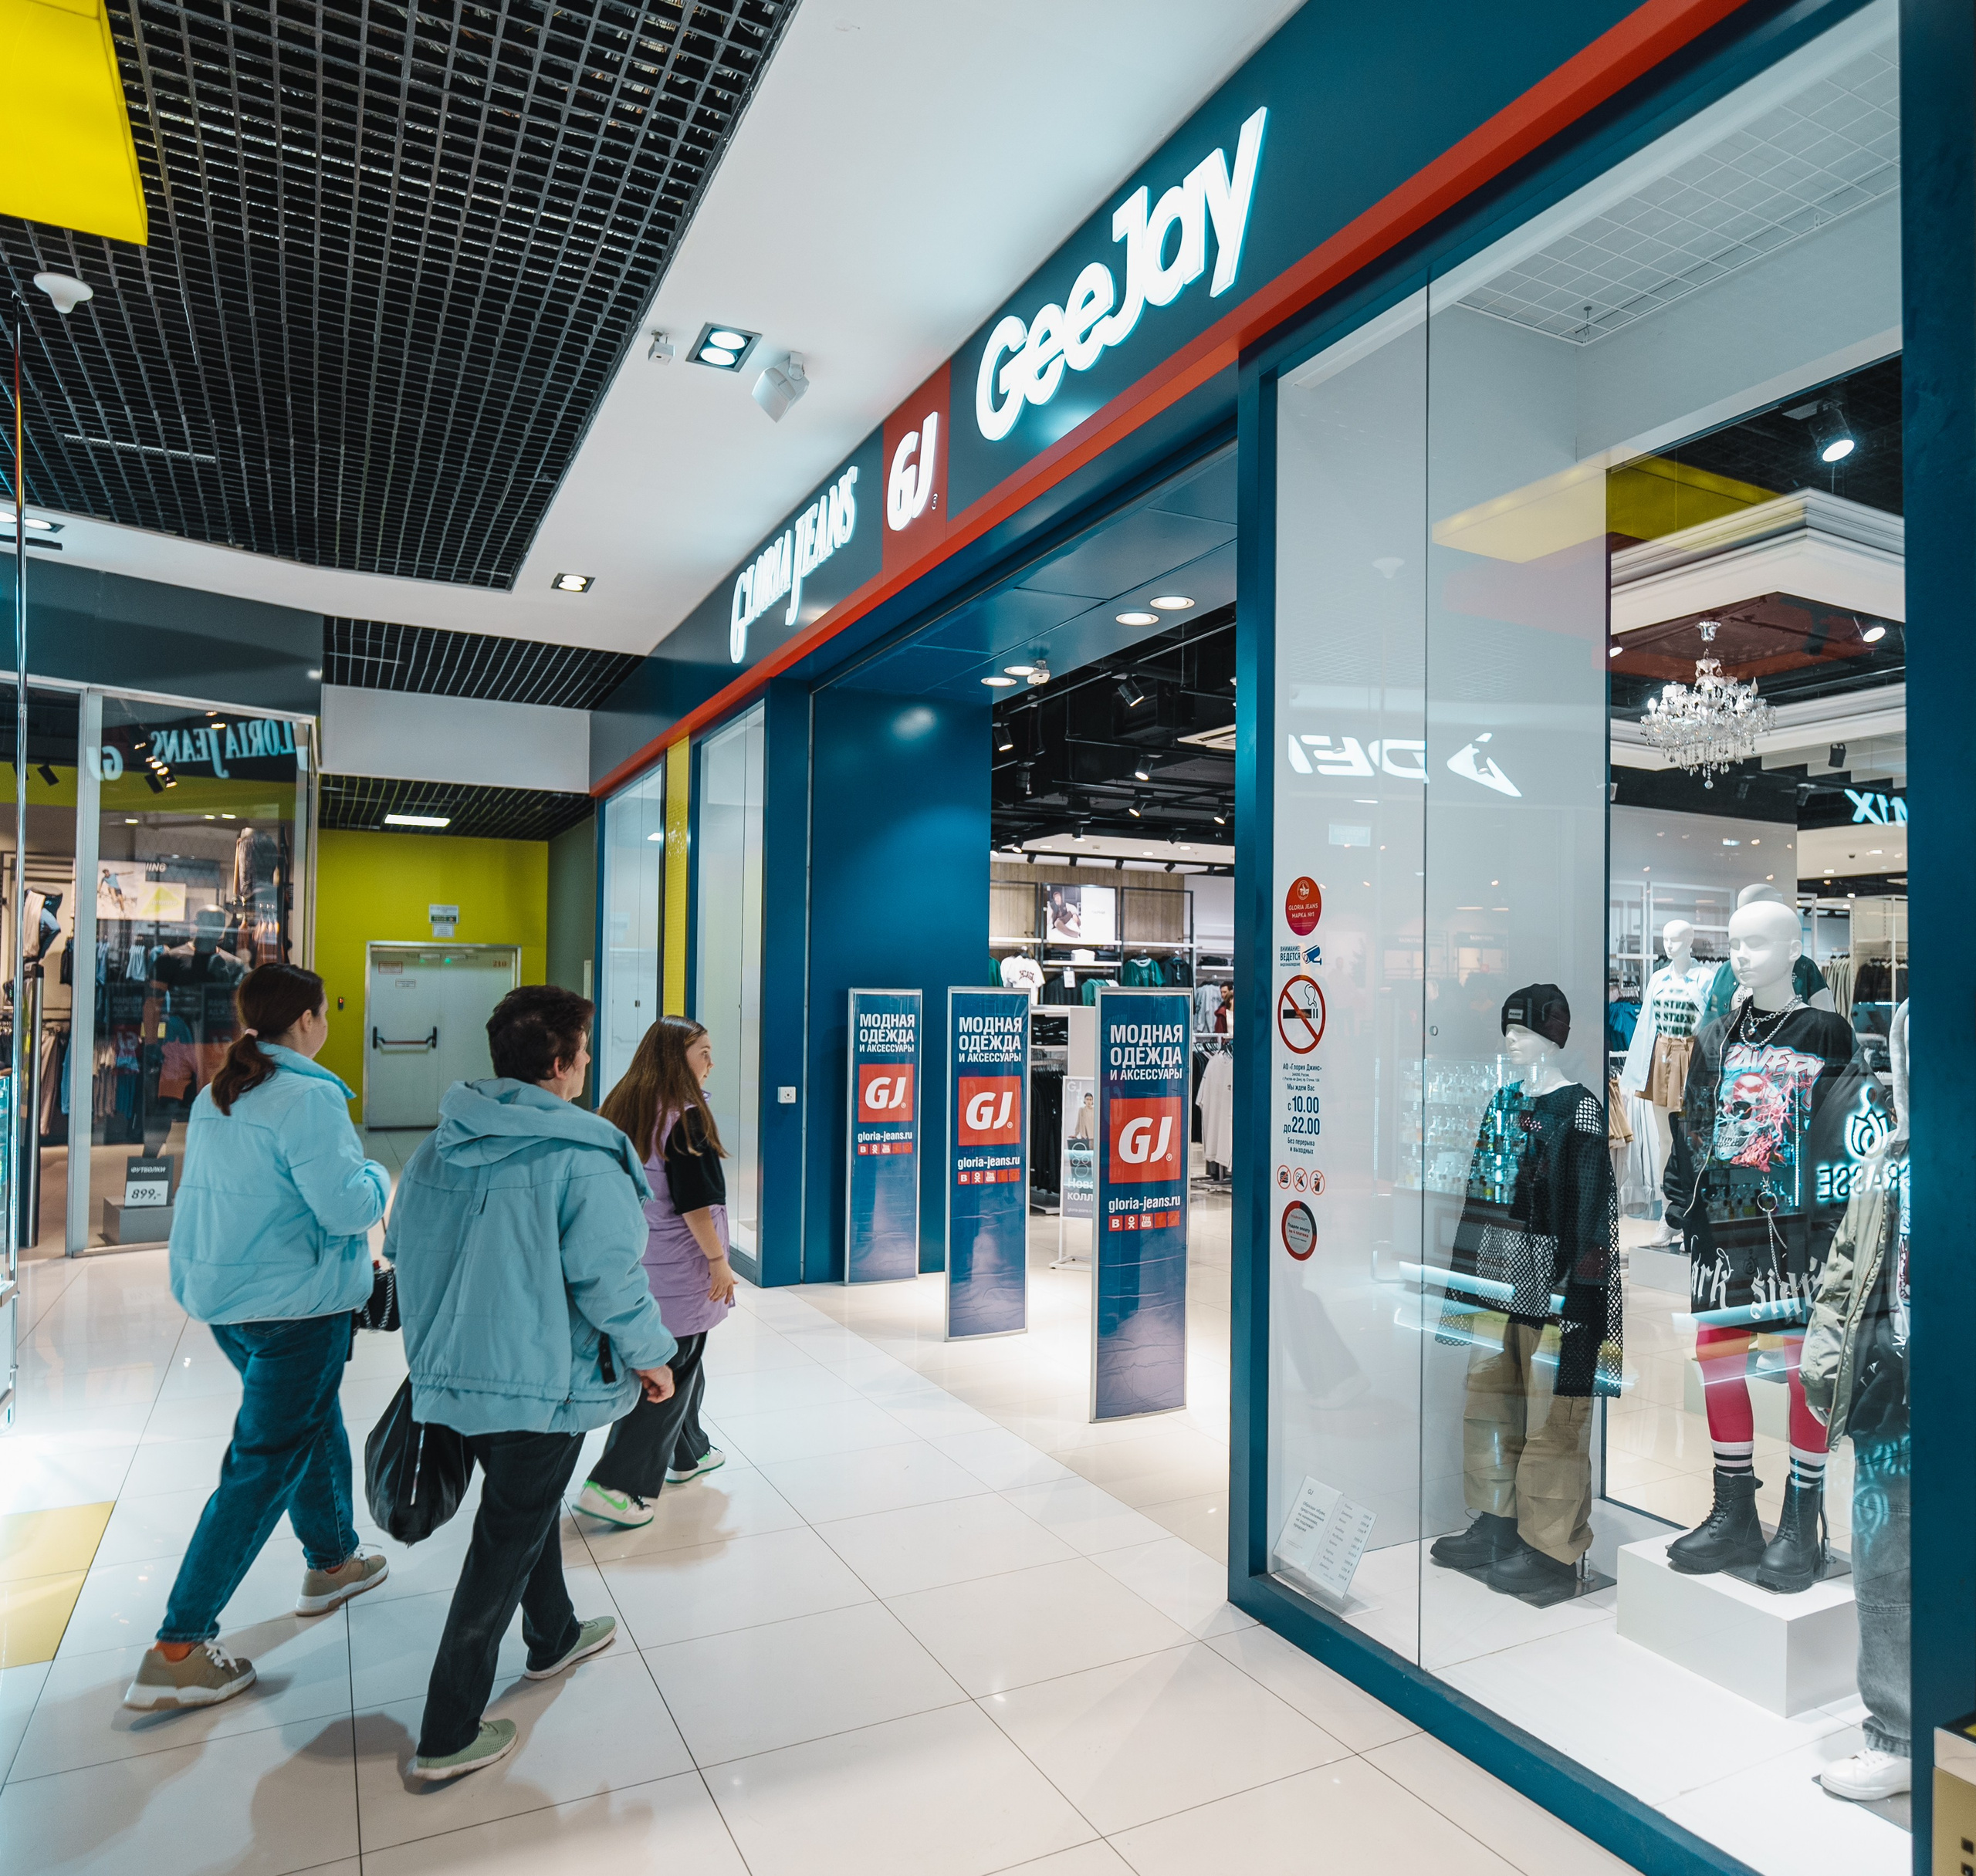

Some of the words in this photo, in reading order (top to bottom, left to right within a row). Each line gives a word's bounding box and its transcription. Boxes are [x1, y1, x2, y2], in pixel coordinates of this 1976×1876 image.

[975, 106, 1268, 441] GeeJay
[887, 411, 939, 531] GJ
[729, 529, 792, 664] GLORIA
[784, 465, 859, 626] JEANS
[1280, 952, 1301, 962] ВЕДЕТСЯ
[859, 1013, 915, 1029] МОДНАЯ
[959, 1016, 1022, 1035] МОДНАЯ
[859, 1029, 915, 1044] ОДЕЖДА
[959, 1035, 1021, 1053] ОДЕЖДА
[1110, 1024, 1183, 1046] МОДНАЯ
[867, 1043, 915, 1053] АКСЕССУАРЫ
[1110, 1046, 1182, 1068] ОДЕЖДА
[959, 1053, 965, 1063] И
[967, 1053, 1021, 1063] АКСЕССУАРЫ
[1110, 1070, 1118, 1080] И
[1120, 1068, 1183, 1080] АКСЕССУАРЫ
[864, 1077, 906, 1110] GJ
[1067, 1080, 1082, 1093] GJ
[966, 1091, 1013, 1131] GJ
[1287, 1102, 1291, 1110] с
[1291, 1095, 1319, 1114] 10.00
[1283, 1124, 1291, 1134] до
[1291, 1116, 1320, 1135] 22.00
[858, 1131, 913, 1143] gloria-jeans.ru
[1118, 1116, 1172, 1164] GJ
[957, 1156, 1020, 1170] gloria-jeans.ru
[1068, 1177, 1093, 1189] Нова
[1067, 1192, 1093, 1202] колл
[1108, 1195, 1180, 1213] gloria-jeans.ru
